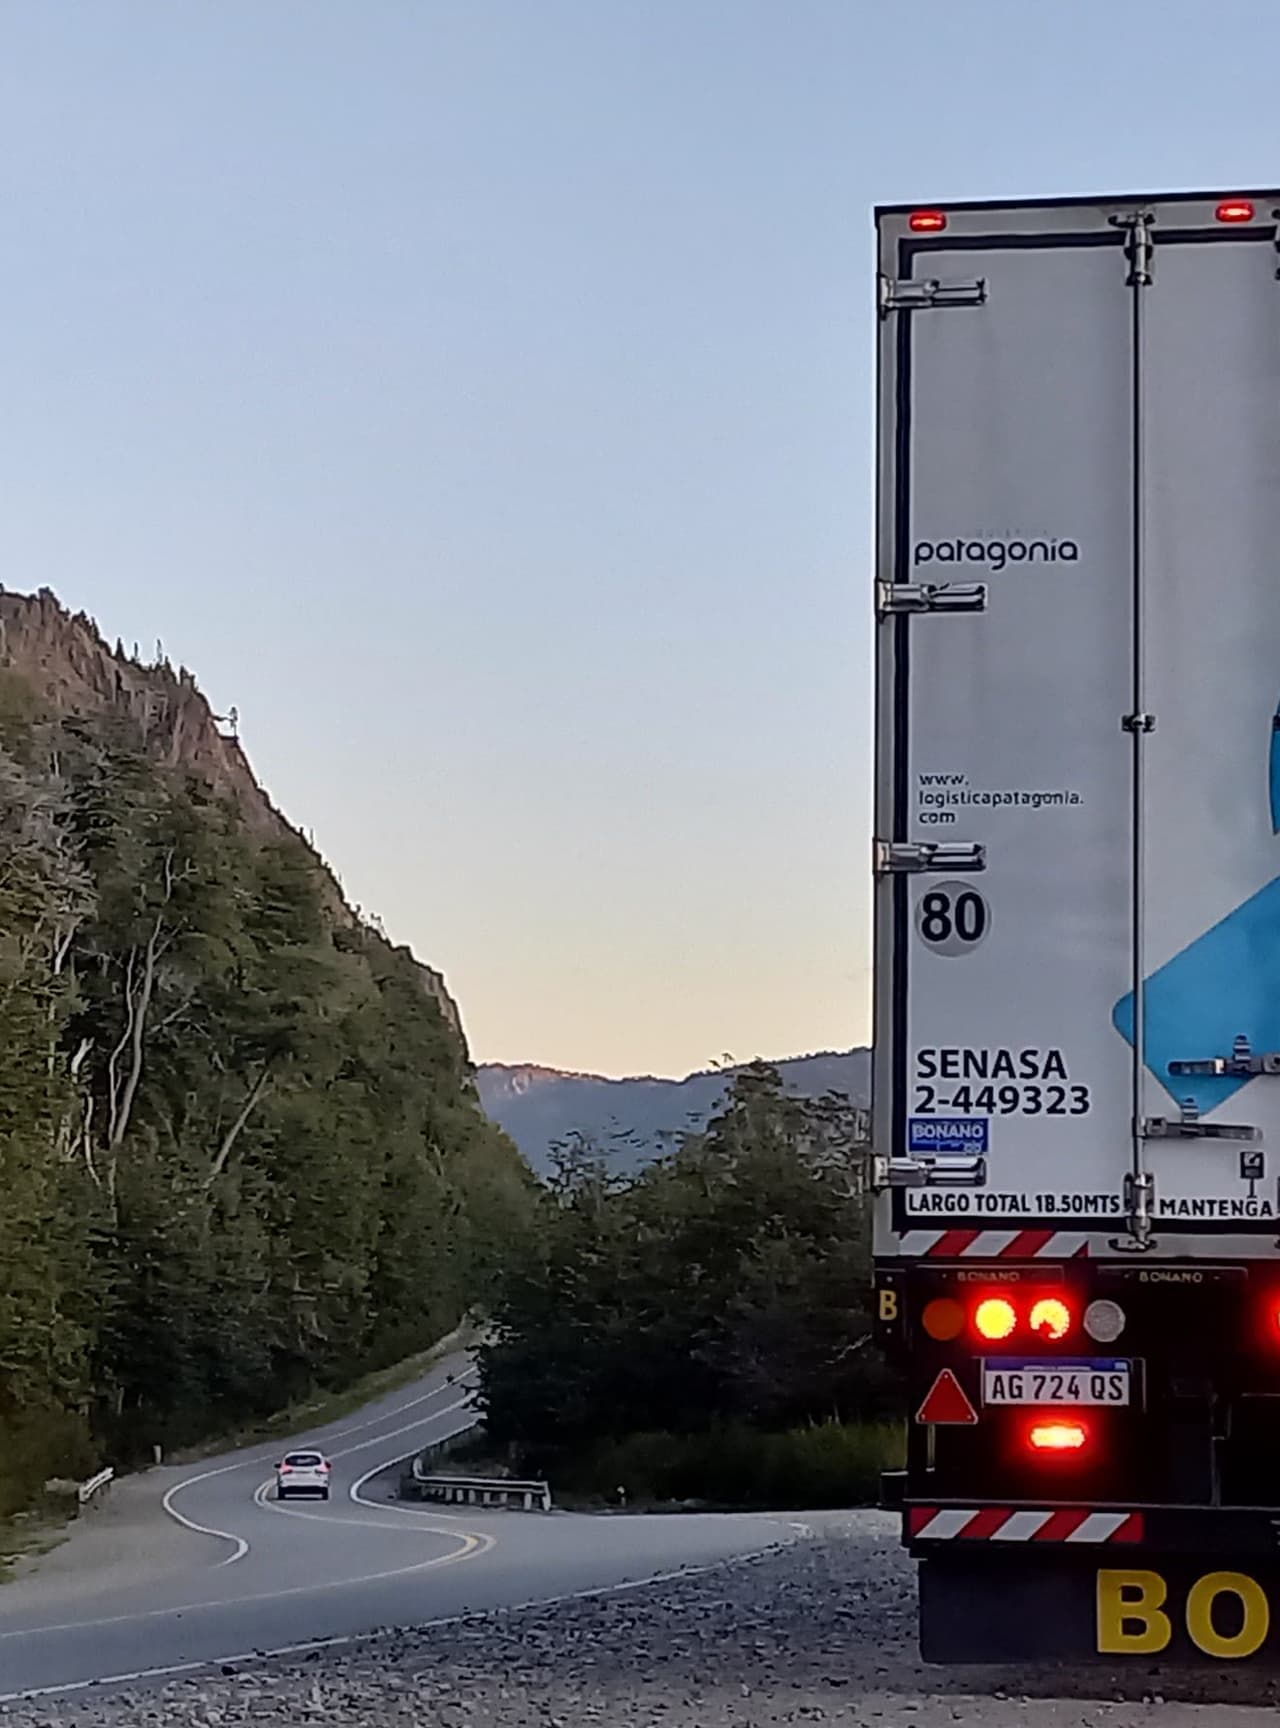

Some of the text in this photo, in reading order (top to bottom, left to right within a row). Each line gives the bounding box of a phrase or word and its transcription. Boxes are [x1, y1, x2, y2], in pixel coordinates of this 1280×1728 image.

[914, 538, 1079, 570] patagonia
[919, 774, 969, 786] www.
[919, 790, 1084, 808] logisticapatagonia.
[919, 811, 955, 824] com
[921, 892, 985, 942] 80
[916, 1049, 1068, 1080] SENASA
[914, 1085, 1090, 1115] 2-449323
[912, 1123, 984, 1138] BONANO
[909, 1193, 969, 1212] LARGO
[976, 1194, 1031, 1213] TOTAL
[1160, 1199, 1273, 1217] MANTENGA
[879, 1289, 897, 1320] B
[992, 1375, 1124, 1400] AG 724 QS
